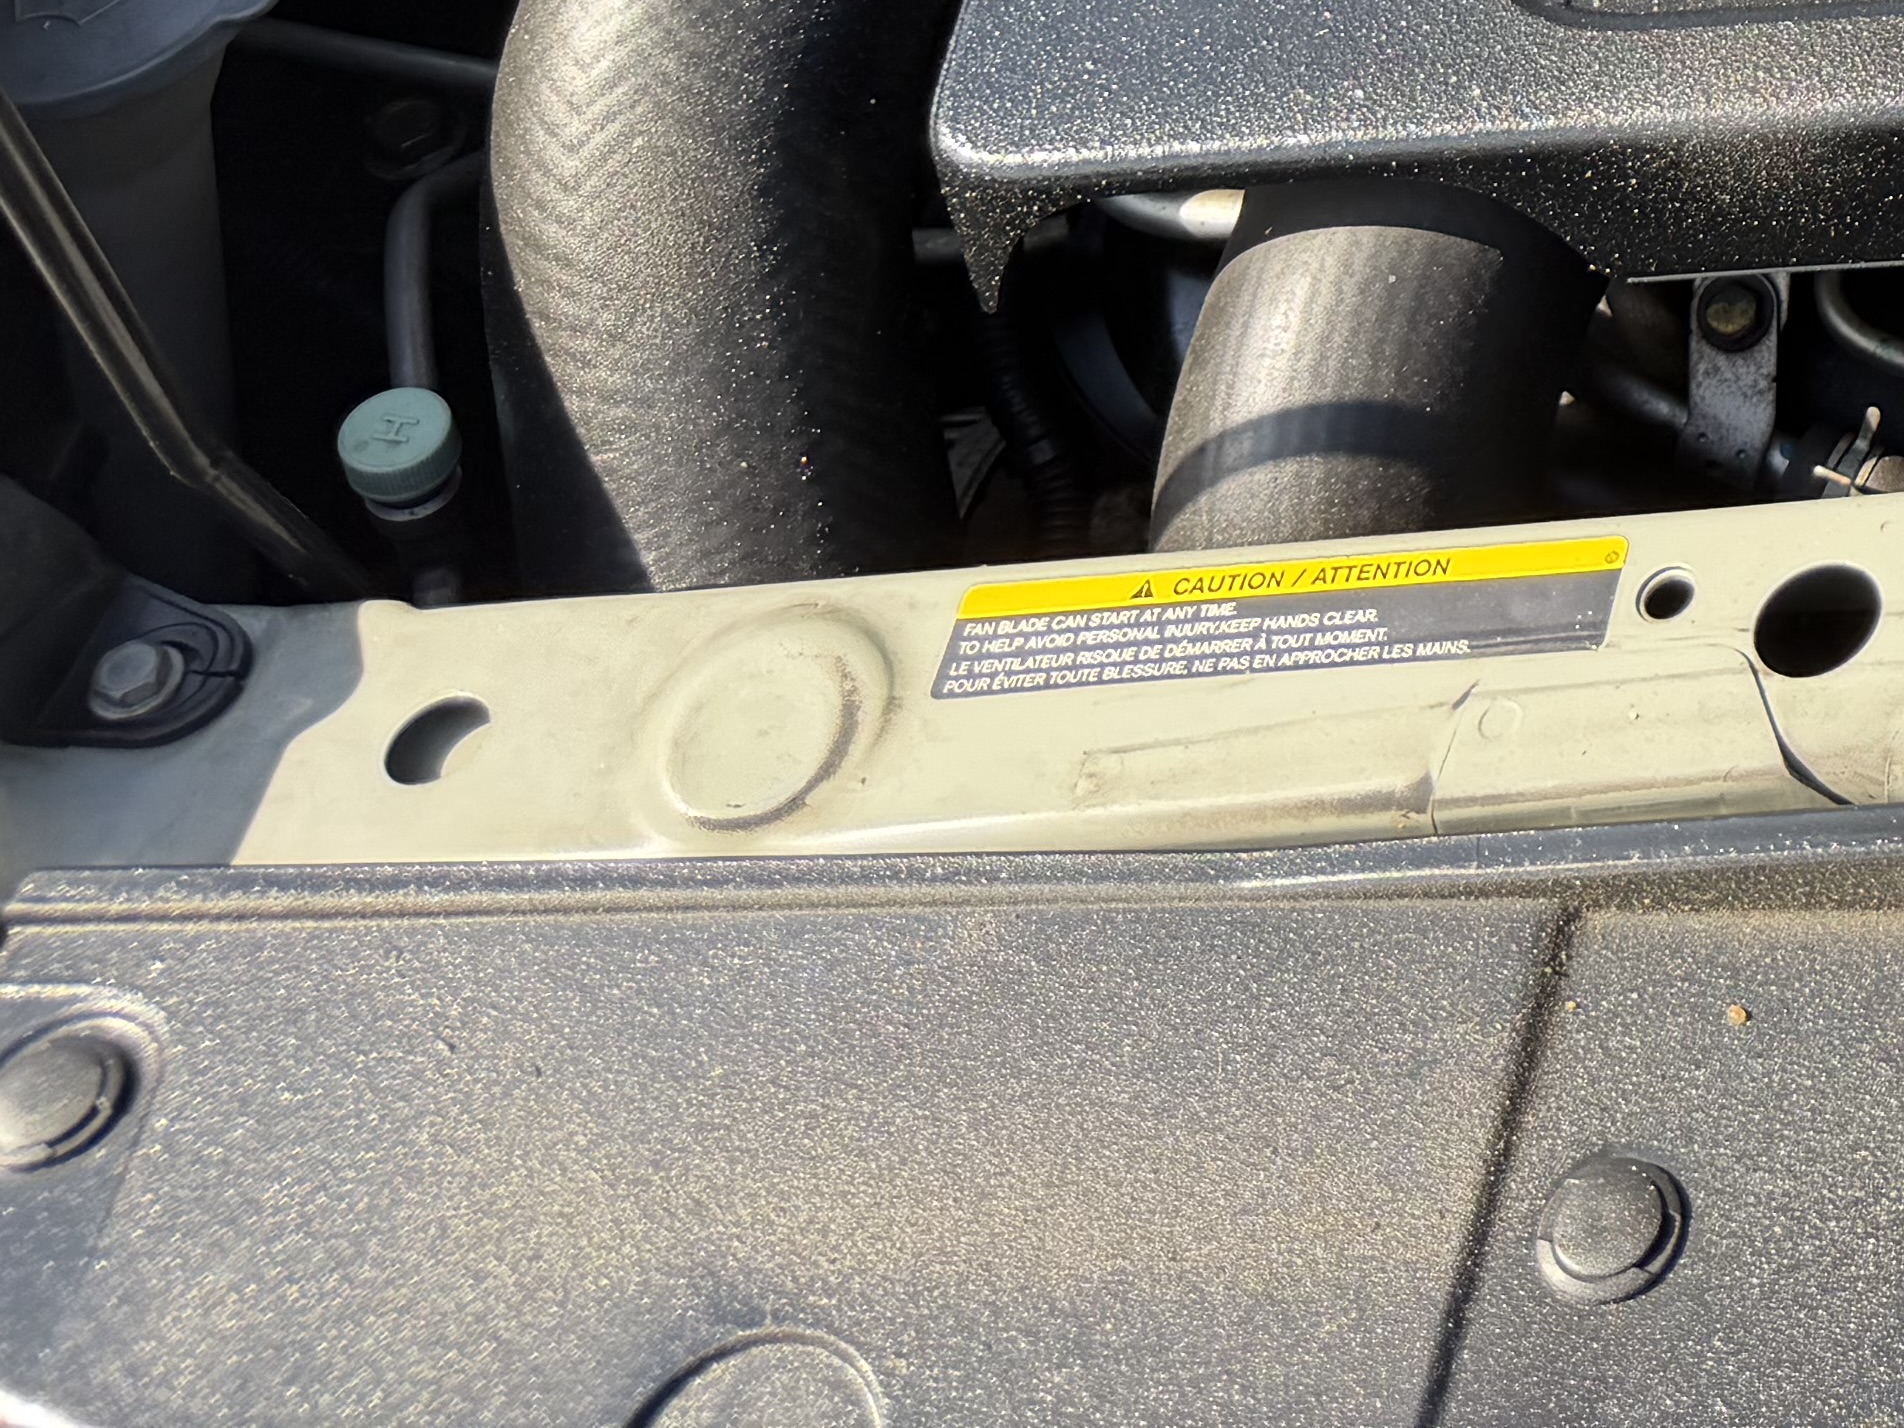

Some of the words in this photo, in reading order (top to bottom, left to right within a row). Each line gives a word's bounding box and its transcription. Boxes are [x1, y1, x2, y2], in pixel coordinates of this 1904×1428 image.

[1173, 570, 1285, 597] CAUTION
[1291, 568, 1308, 588] /
[1311, 558, 1452, 586] ATTENTION
[959, 640, 980, 655] TO
[982, 637, 1024, 654] HELP
[1025, 632, 1075, 650] AVOID
[1076, 626, 1160, 646] PERSONAL
[1263, 612, 1320, 630] HANDS
[1321, 607, 1379, 626] CLEAR.
[963, 621, 996, 637] FAN
[997, 616, 1049, 635] BLADE
[1050, 614, 1088, 631] CAN
[1088, 610, 1138, 628] START
[1139, 608, 1161, 623] AT
[1161, 605, 1198, 620] ANY
[1200, 601, 1238, 619] TIME.
[943, 677, 989, 694] POUR
[992, 671, 1046, 691] ÉVITER
[1048, 668, 1100, 685] TOUTE
[1191, 657, 1215, 673] NE
[1217, 655, 1251, 671] PAS
[1252, 652, 1277, 668] EN
[1278, 645, 1380, 666] APPROCHER
[1382, 642, 1413, 658] LES
[1415, 638, 1471, 656] MAINS.
[949, 660, 971, 676] LE
[974, 653, 1074, 674] VENTILATEUR
[1076, 646, 1135, 665] RISQUE
[1138, 643, 1161, 659] DE
[1164, 636, 1253, 658] DÉMARRER
[1256, 632, 1267, 650] À
[1270, 632, 1313, 649] TOUT
[1315, 627, 1388, 647] MOMENT.
